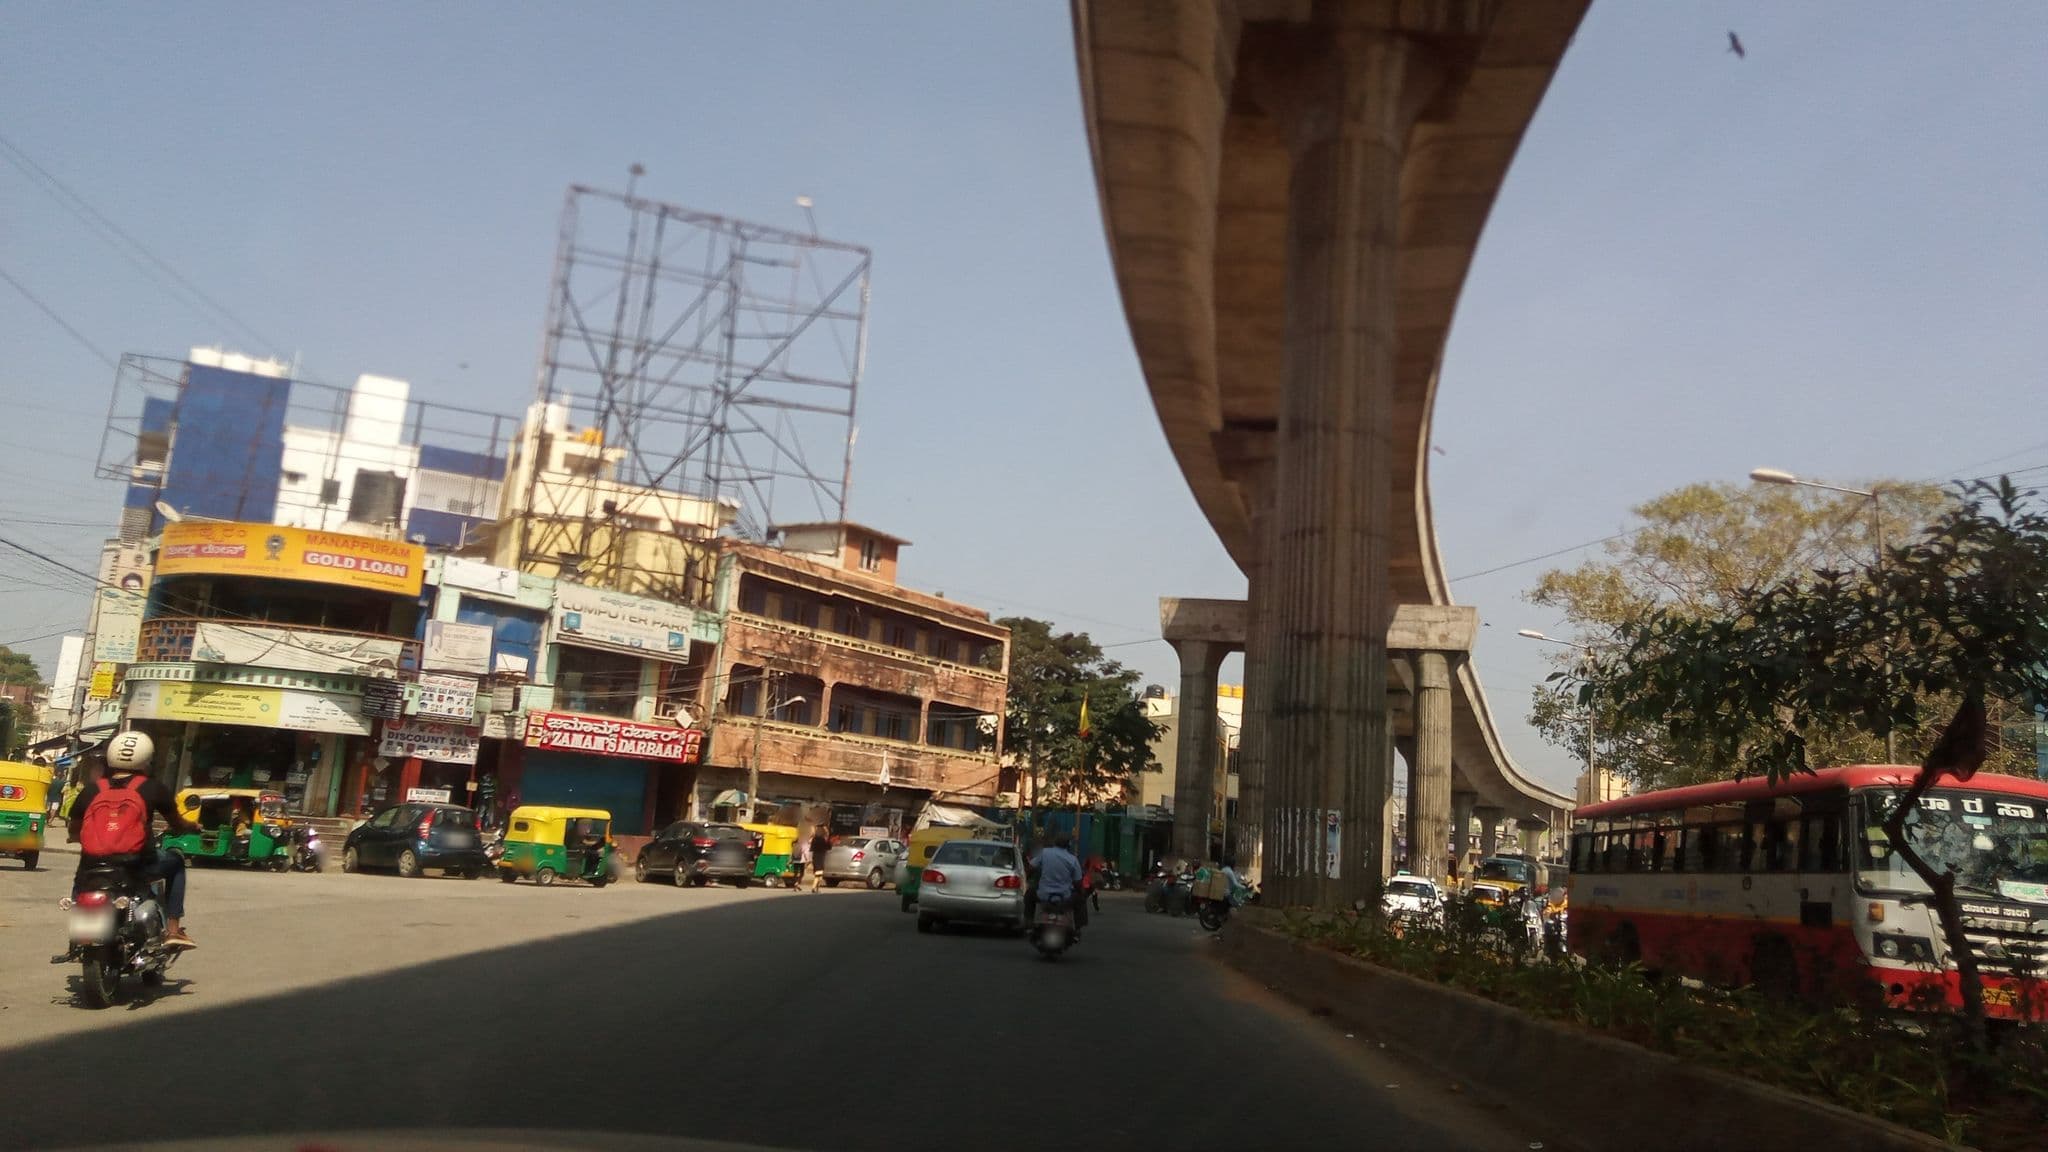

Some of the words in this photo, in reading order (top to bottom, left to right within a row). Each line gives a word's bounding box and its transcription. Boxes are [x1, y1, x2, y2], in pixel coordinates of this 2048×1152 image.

[307, 534, 410, 557] MANAPPURAM
[306, 552, 356, 569] GOLD
[361, 559, 407, 577] LOAN
[387, 731, 446, 745] DISCOUNT
[449, 737, 477, 747] SALE
[616, 738, 684, 759] DARBAAR
